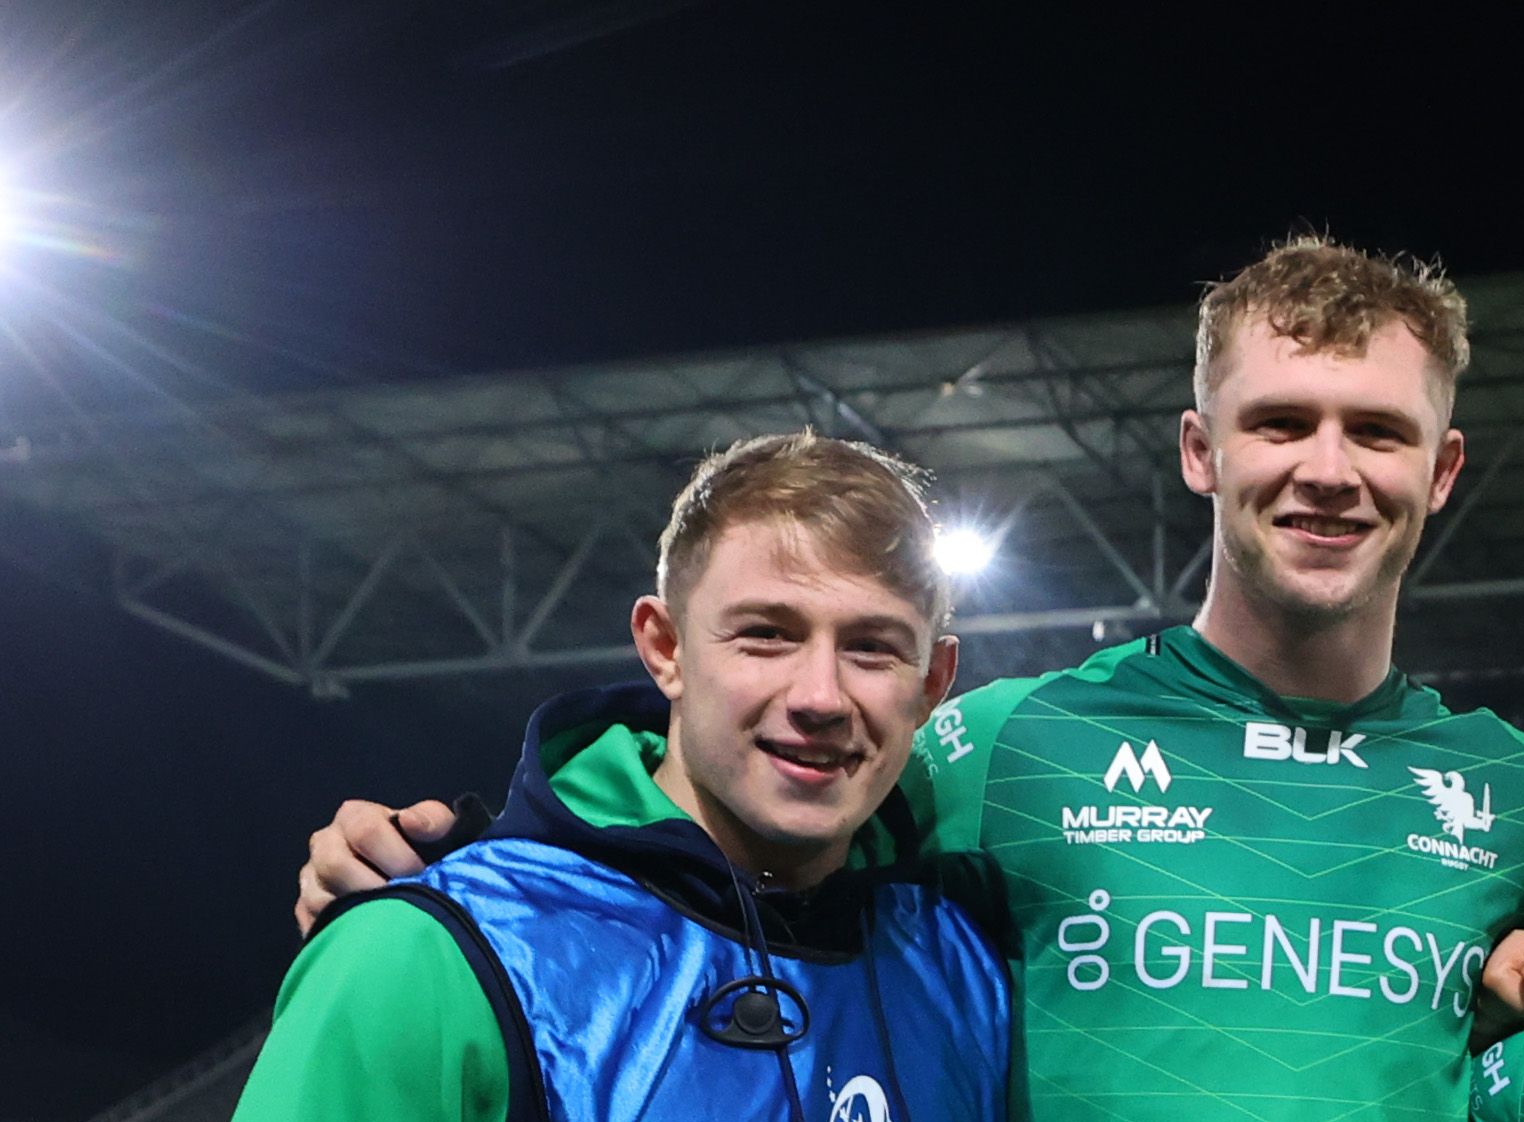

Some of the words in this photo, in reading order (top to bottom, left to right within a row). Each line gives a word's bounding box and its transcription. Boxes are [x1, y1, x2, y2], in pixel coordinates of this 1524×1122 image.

[1243, 722, 1369, 769] BLK
[1062, 806, 1213, 829] MURRAY
[1063, 829, 1132, 845] TIMBER
[1137, 829, 1206, 844] GROUP
[1407, 833, 1499, 869] CONNACHT
[1133, 910, 1485, 1018] GENESYS
